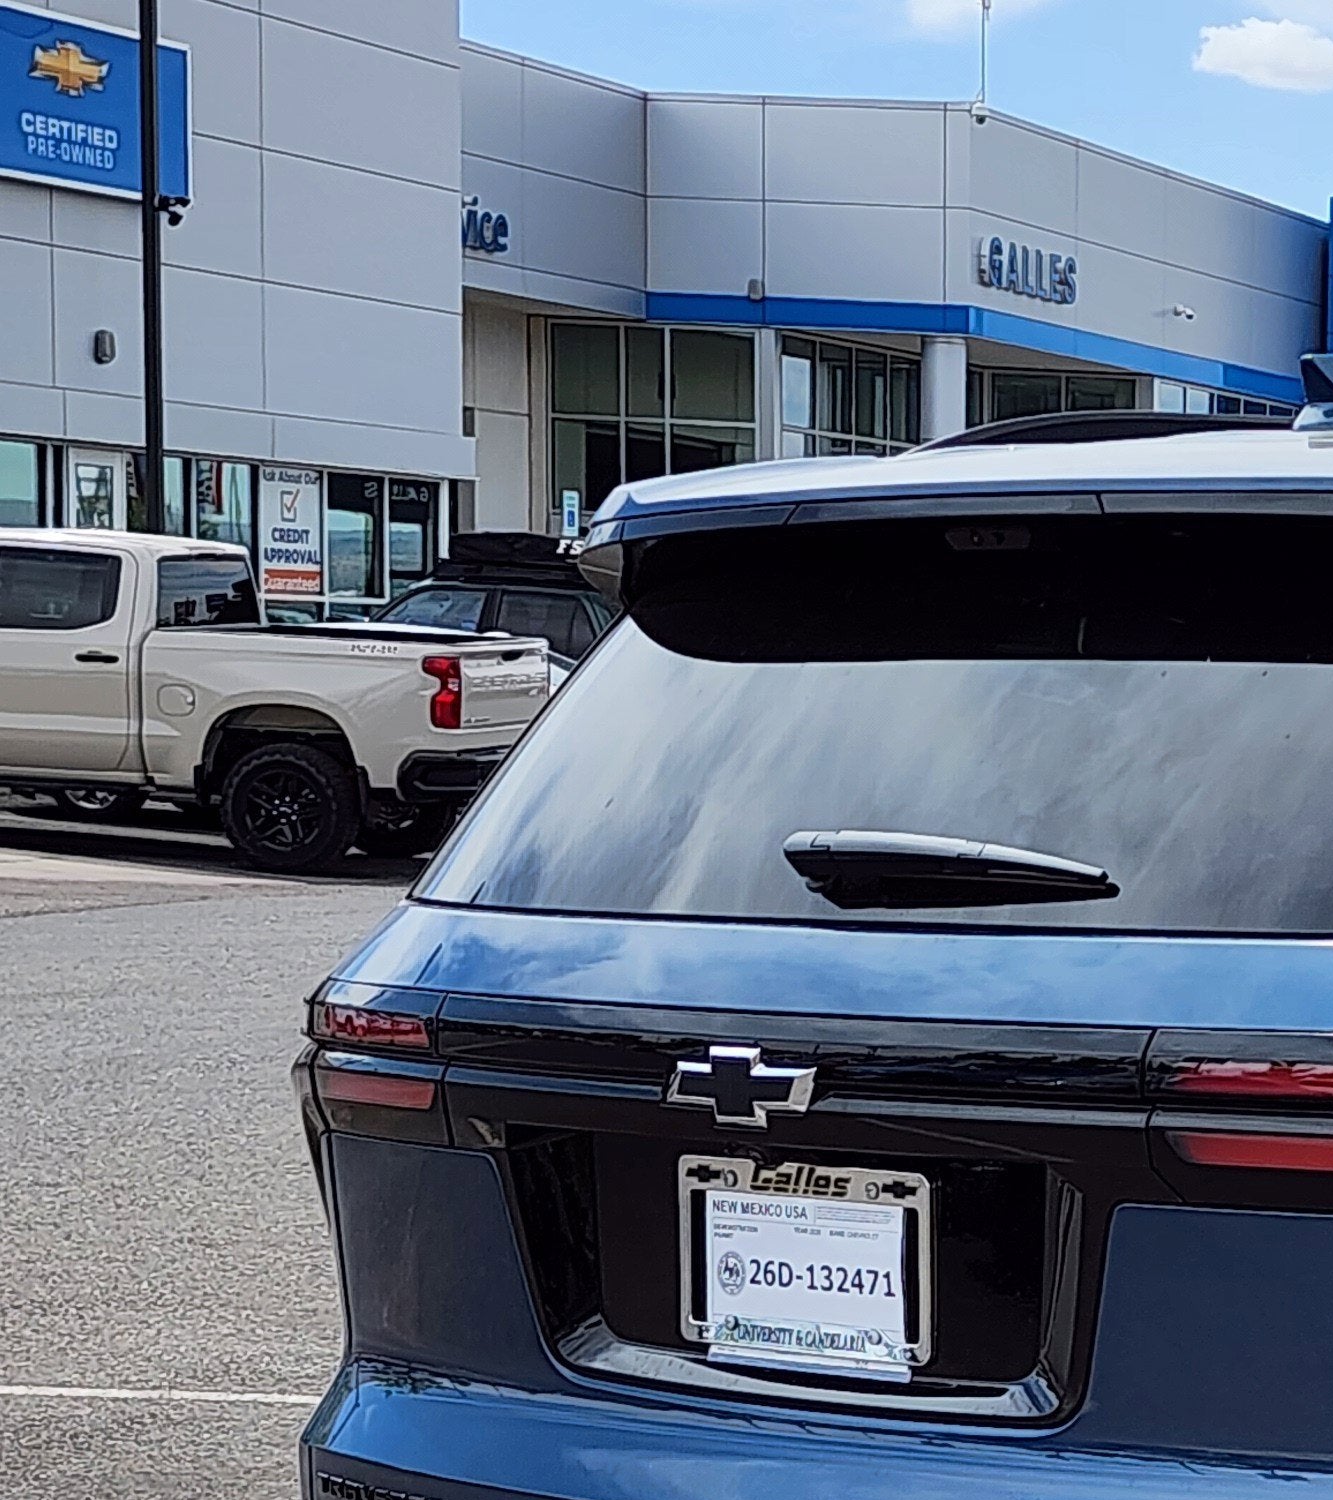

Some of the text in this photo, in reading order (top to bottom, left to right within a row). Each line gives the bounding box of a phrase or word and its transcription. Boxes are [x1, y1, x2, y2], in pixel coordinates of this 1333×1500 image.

[21, 111, 118, 149] CERTIFIED
[27, 135, 115, 169] PRE-OWNED
[984, 236, 1077, 305] GALLES
[271, 527, 311, 545] CREDIT
[750, 1164, 852, 1198] Galles
[713, 1200, 738, 1214] NEW
[741, 1202, 783, 1217] MEXICO
[785, 1205, 808, 1220] USA
[749, 1258, 896, 1298] 26D-132471
